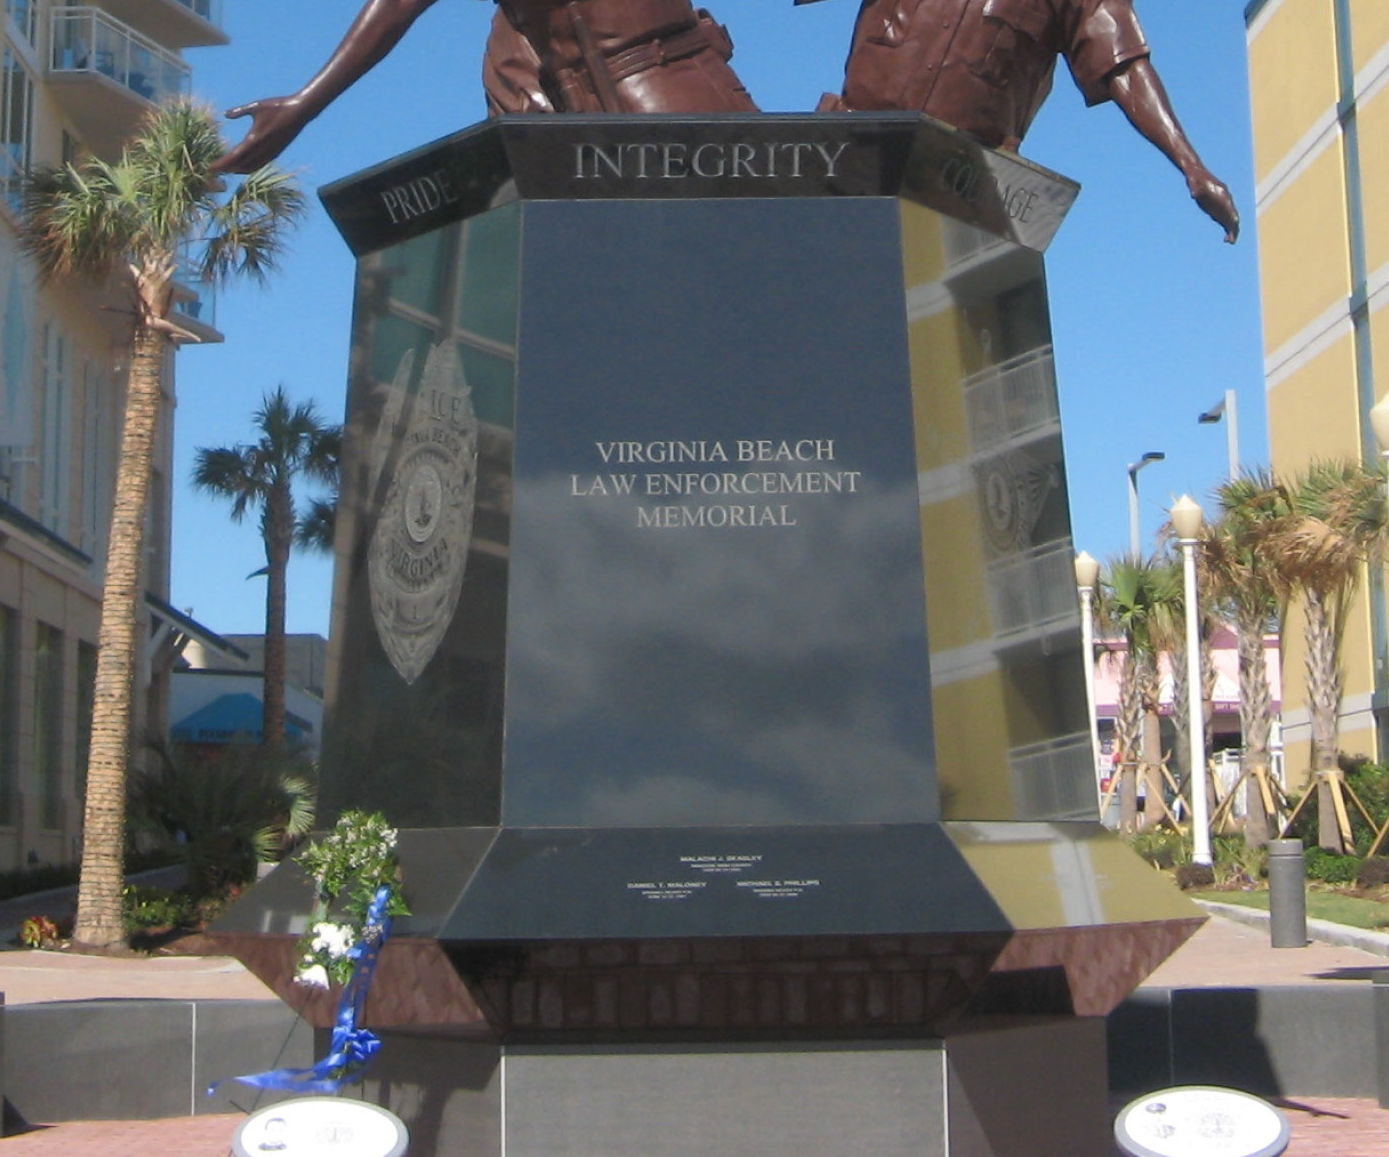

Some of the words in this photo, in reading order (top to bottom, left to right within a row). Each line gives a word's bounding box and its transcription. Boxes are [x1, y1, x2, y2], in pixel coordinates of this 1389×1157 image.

[573, 142, 850, 178] INTEGRITY
[380, 169, 458, 224] PRIDE
[940, 158, 1040, 224] COUAGE
[596, 442, 728, 463] VIRGINIA
[737, 439, 835, 462] BEACH
[571, 474, 636, 496] LAW
[645, 471, 860, 495] ENFORCEMENT
[636, 505, 796, 528] MEMORIAL
